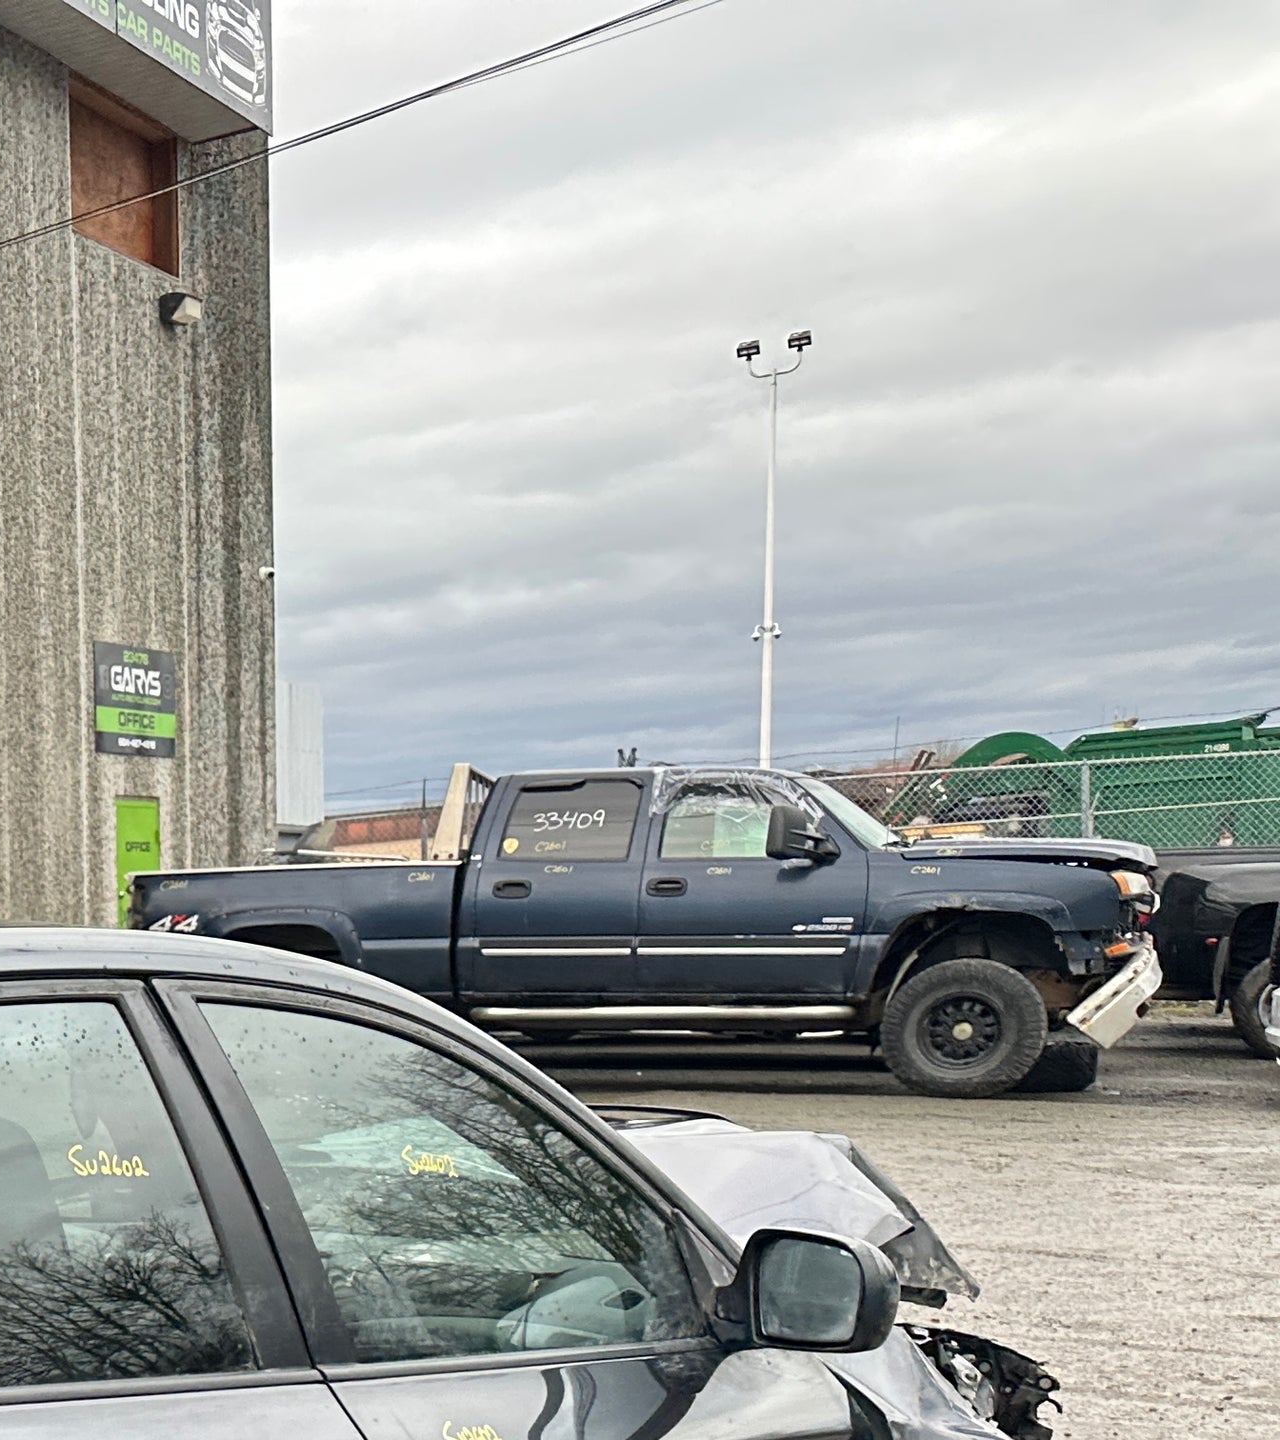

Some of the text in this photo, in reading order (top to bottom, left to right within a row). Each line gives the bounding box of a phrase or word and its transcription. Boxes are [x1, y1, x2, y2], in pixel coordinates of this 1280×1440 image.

[117, 2, 201, 76] CAR PARTS
[110, 665, 161, 697] GARYS
[118, 711, 156, 730] OFFICE
[533, 809, 607, 832] 33409
[125, 841, 151, 852] OFFICE
